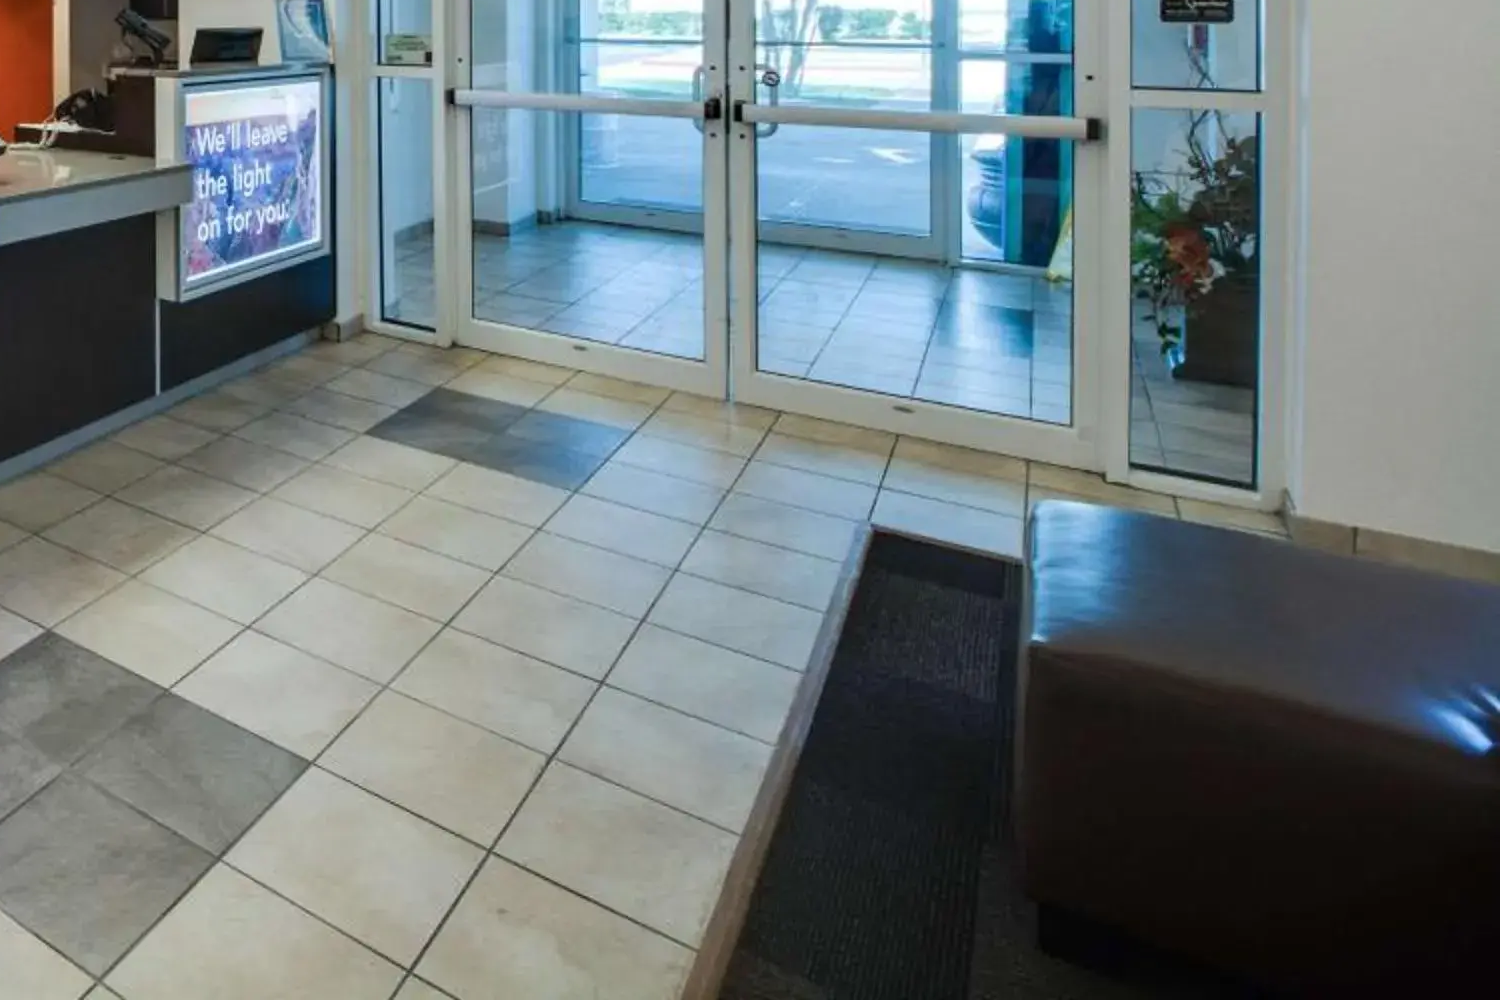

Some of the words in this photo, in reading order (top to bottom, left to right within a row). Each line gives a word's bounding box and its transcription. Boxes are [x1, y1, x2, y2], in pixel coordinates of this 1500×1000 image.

[197, 120, 240, 156] We'll
[246, 119, 288, 147] leave
[197, 167, 227, 199] the
[233, 159, 272, 197] light
[197, 218, 220, 241] on
[226, 204, 252, 234] for
